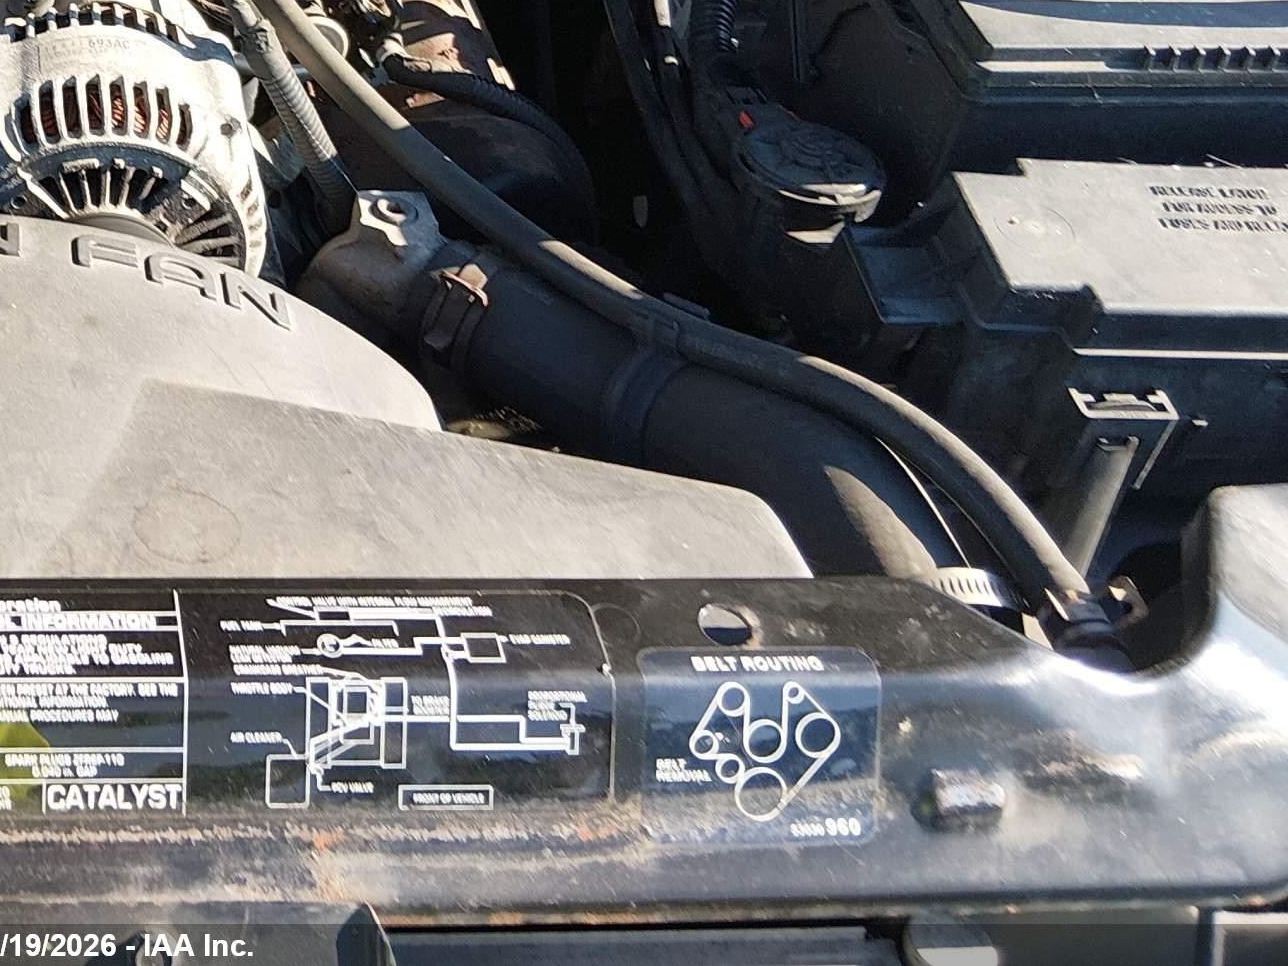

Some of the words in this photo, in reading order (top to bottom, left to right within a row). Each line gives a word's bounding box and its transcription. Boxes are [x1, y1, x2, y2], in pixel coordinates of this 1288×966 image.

[70, 233, 293, 332] FAN
[20, 615, 157, 627] INFORMATION
[690, 656, 737, 672] BELT
[740, 656, 825, 672] ROUTING
[96, 711, 119, 722] MAY
[47, 784, 182, 811] CATALYST
[824, 818, 861, 836] 960
